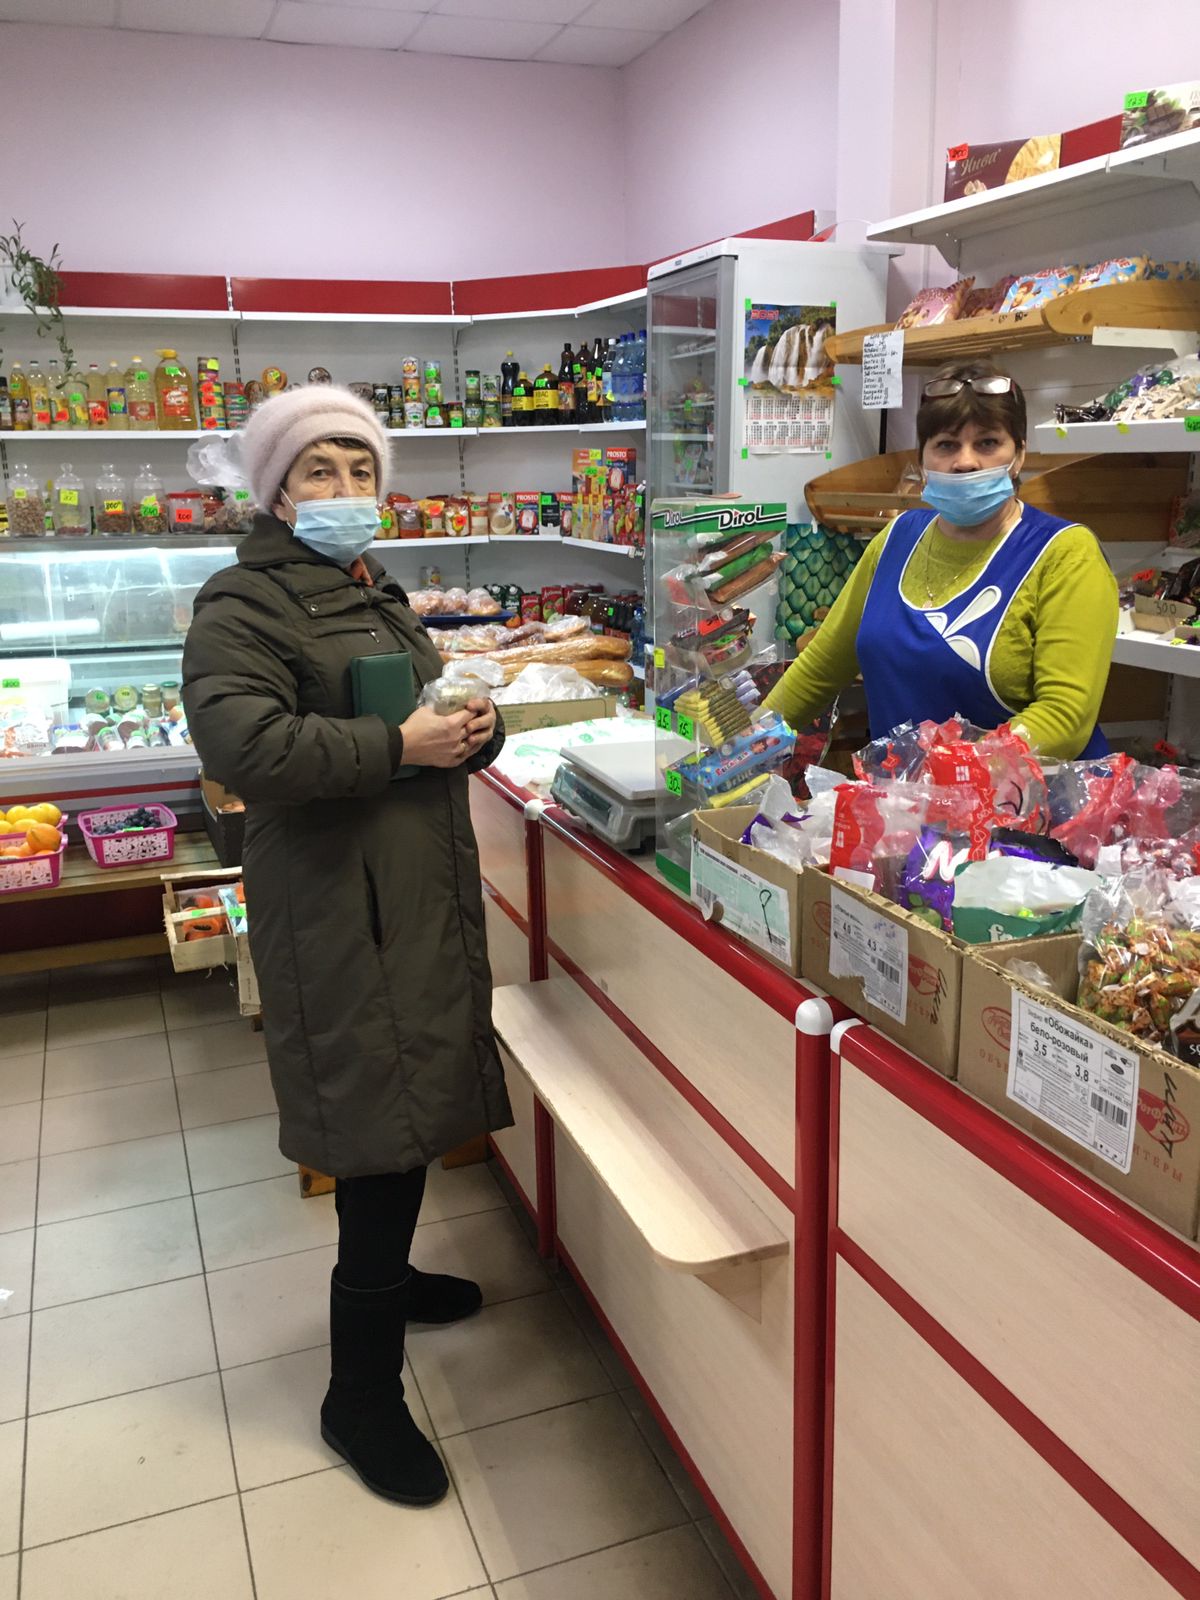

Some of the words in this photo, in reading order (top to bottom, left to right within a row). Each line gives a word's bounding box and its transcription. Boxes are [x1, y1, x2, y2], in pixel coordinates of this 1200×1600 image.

[751, 309, 779, 320] 2021
[1030, 1021, 1089, 1063] бело-розовый
[1044, 1016, 1094, 1050] «Обожайка»
